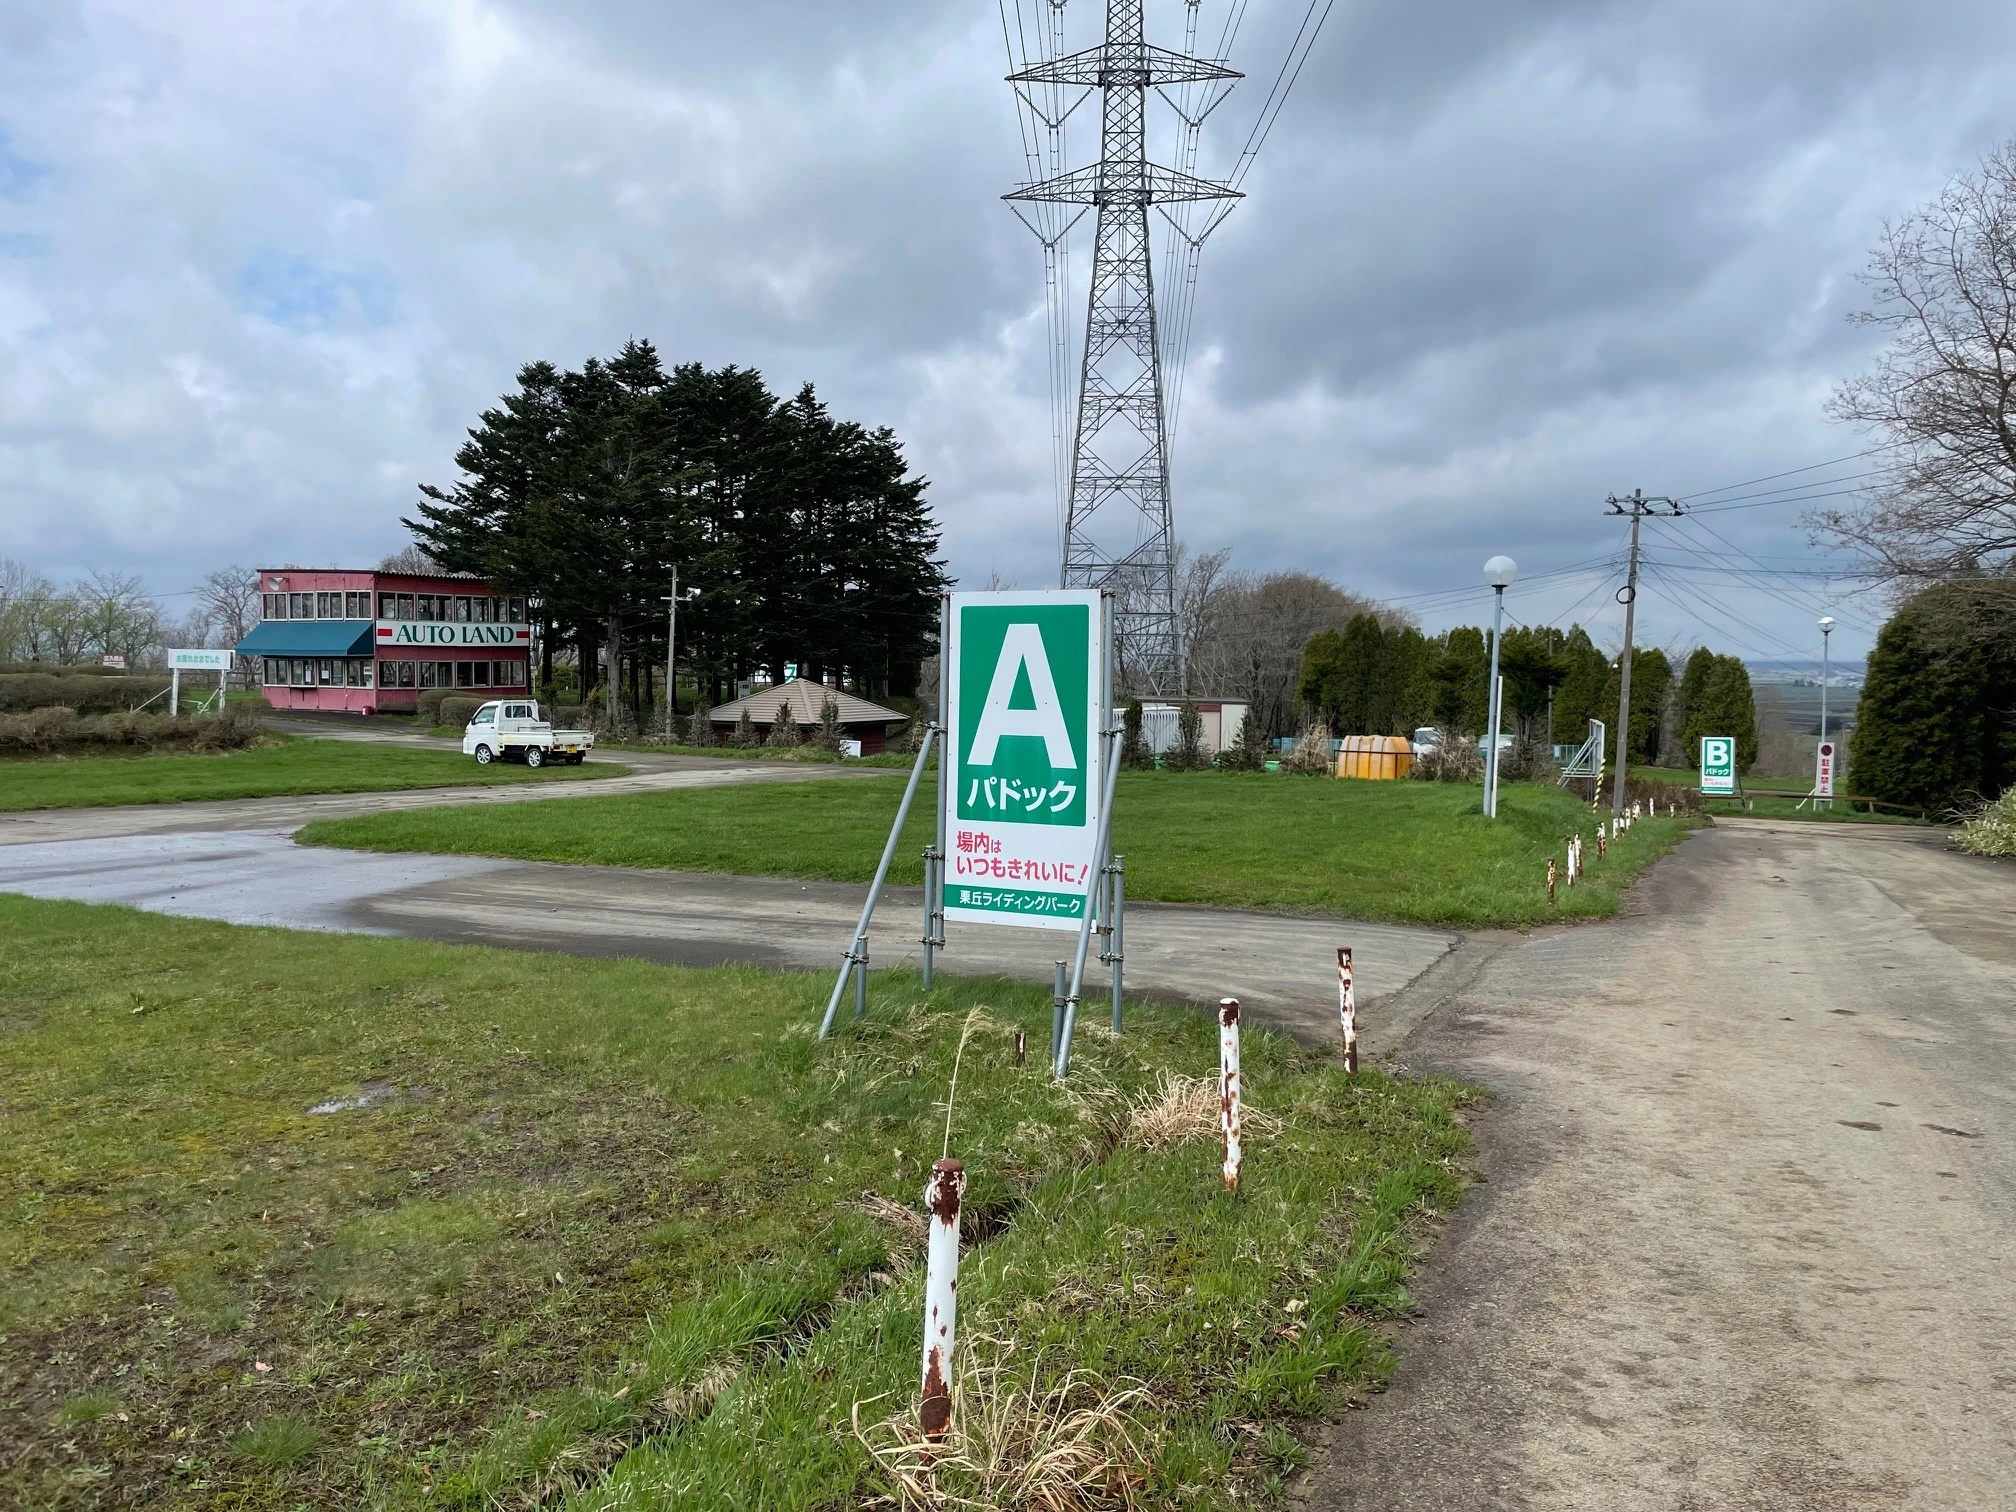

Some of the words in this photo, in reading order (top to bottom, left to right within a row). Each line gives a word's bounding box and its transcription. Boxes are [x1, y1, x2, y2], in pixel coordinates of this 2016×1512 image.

[396, 624, 456, 644] AUTO
[462, 626, 515, 644] LAND
[967, 623, 1078, 770] A
[1706, 740, 1729, 766] B
[966, 776, 1078, 813] パドック
[956, 830, 1002, 854] 場内は
[956, 855, 1089, 886] いつもきれいに!
[959, 889, 1081, 914] 栗丘ライディングパーク
